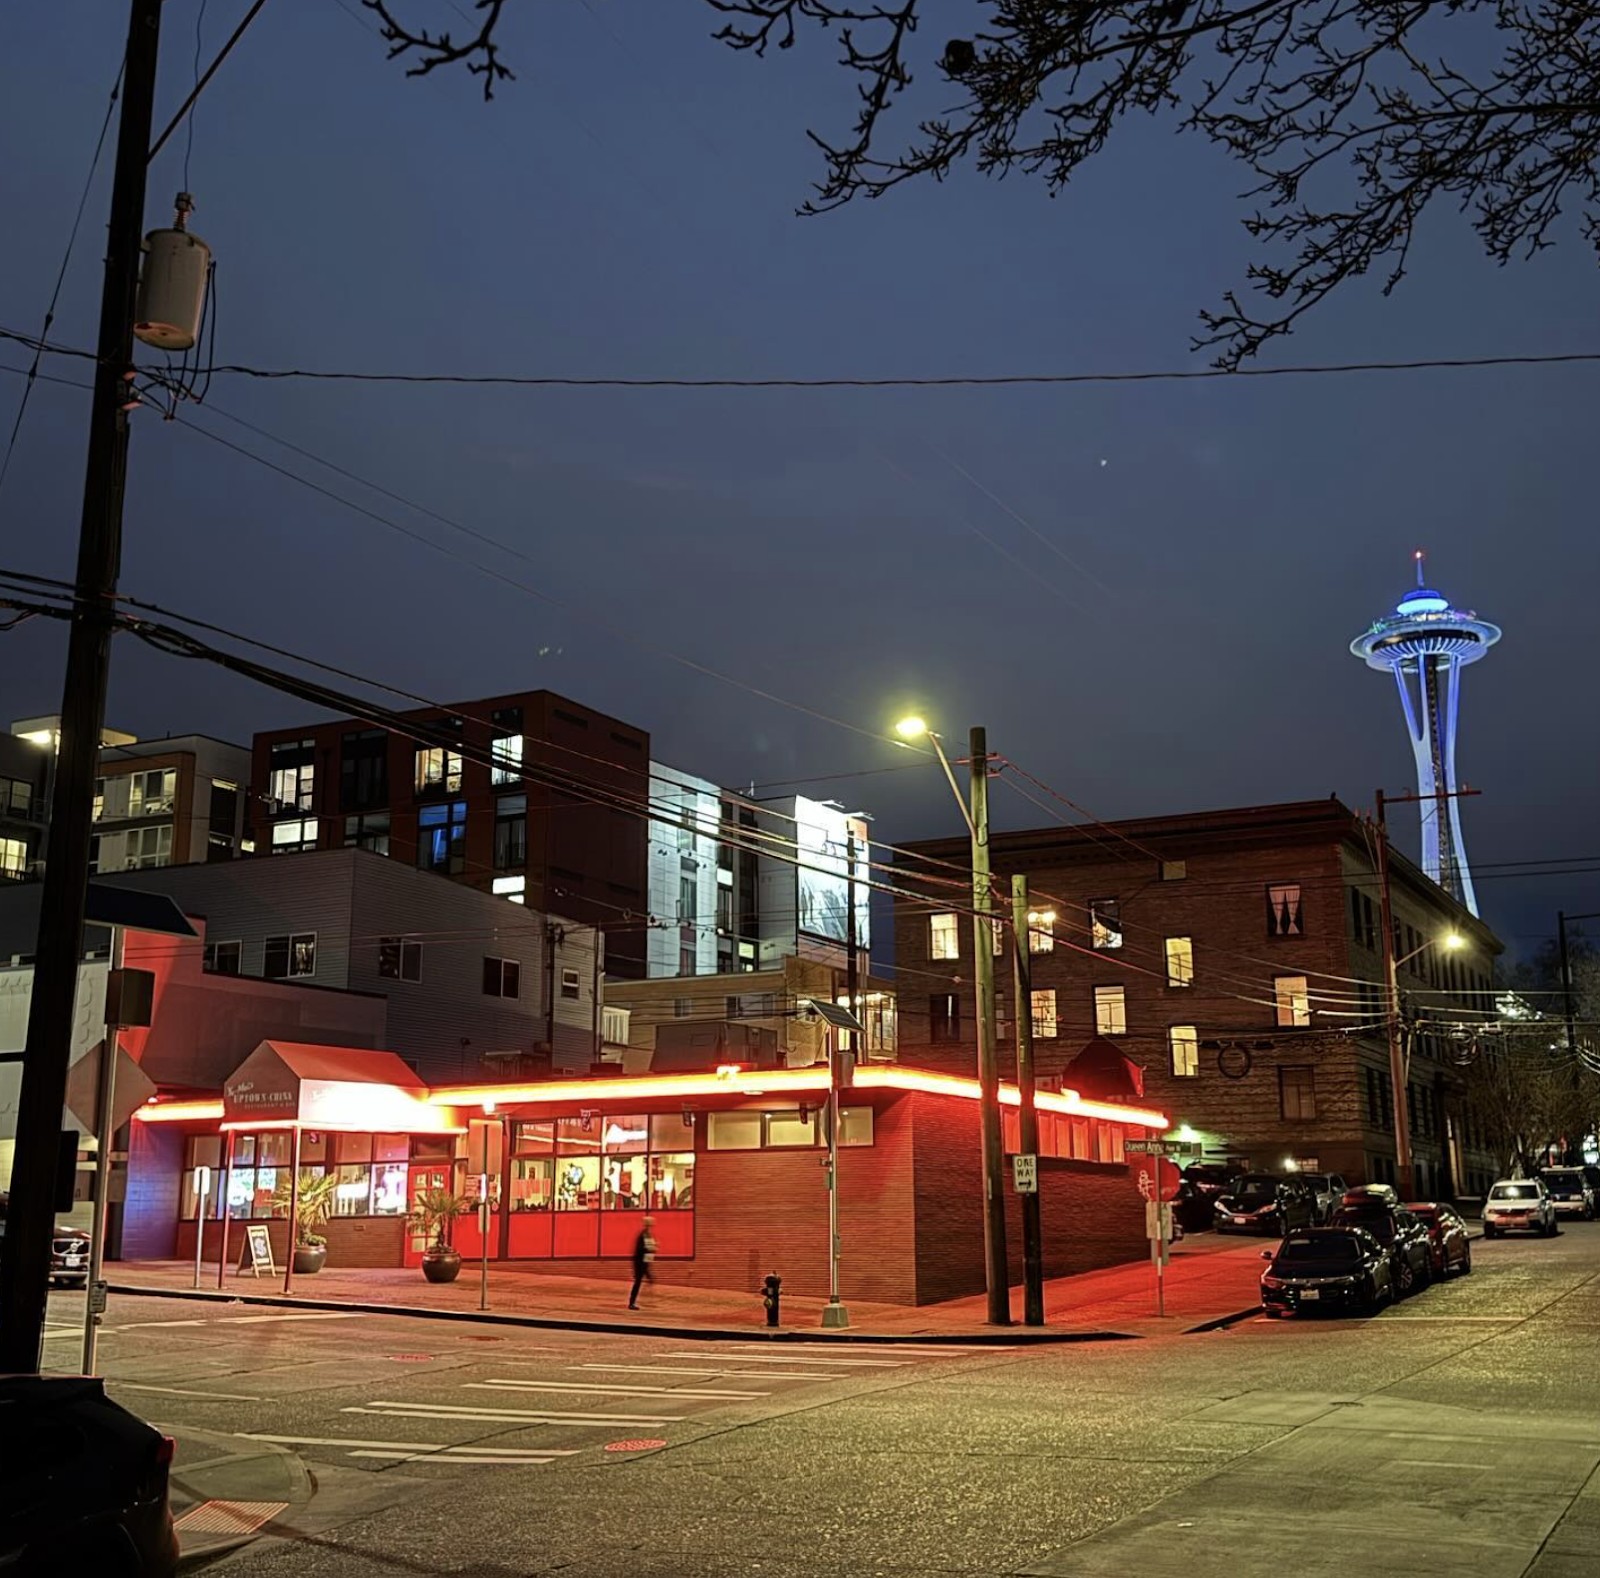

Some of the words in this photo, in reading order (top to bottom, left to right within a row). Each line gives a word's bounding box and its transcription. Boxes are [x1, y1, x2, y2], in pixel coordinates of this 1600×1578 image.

[269, 1091, 292, 1102] CHINA
[1124, 1141, 1146, 1152] Queen
[1016, 1158, 1034, 1168] ONE
[1017, 1168, 1034, 1177] WAY
